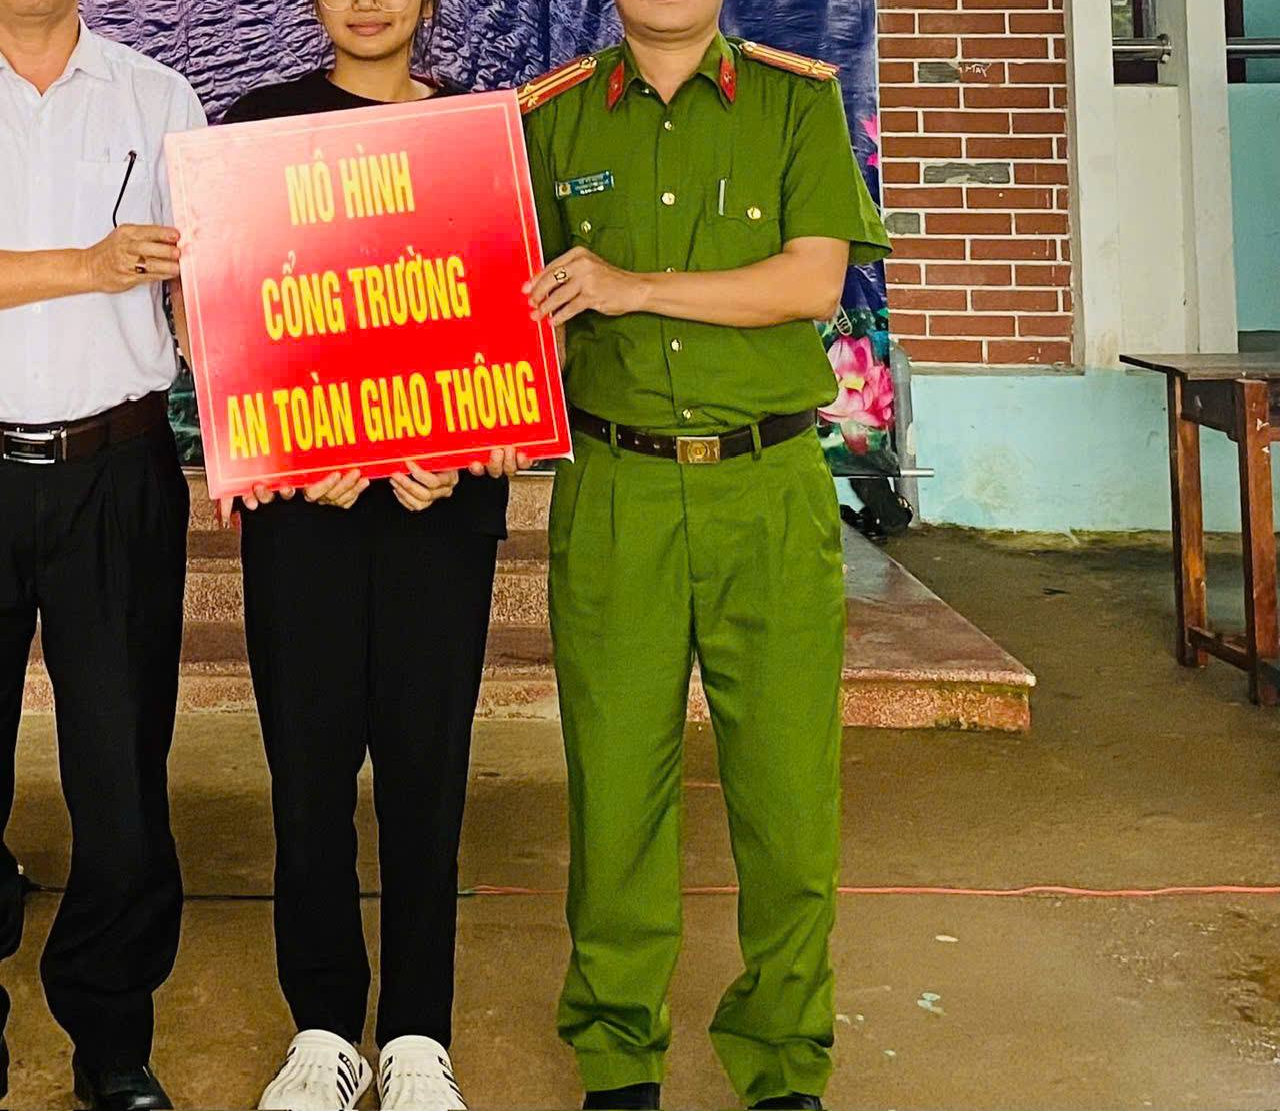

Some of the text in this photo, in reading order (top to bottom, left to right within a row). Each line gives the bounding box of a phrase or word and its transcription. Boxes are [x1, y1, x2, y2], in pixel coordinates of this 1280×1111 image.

[284, 144, 416, 227] MÔ HÌNH
[261, 245, 472, 342] CỔNG TRƯỜNG
[226, 351, 542, 462] AN TOÀN GIAO THÔNG
